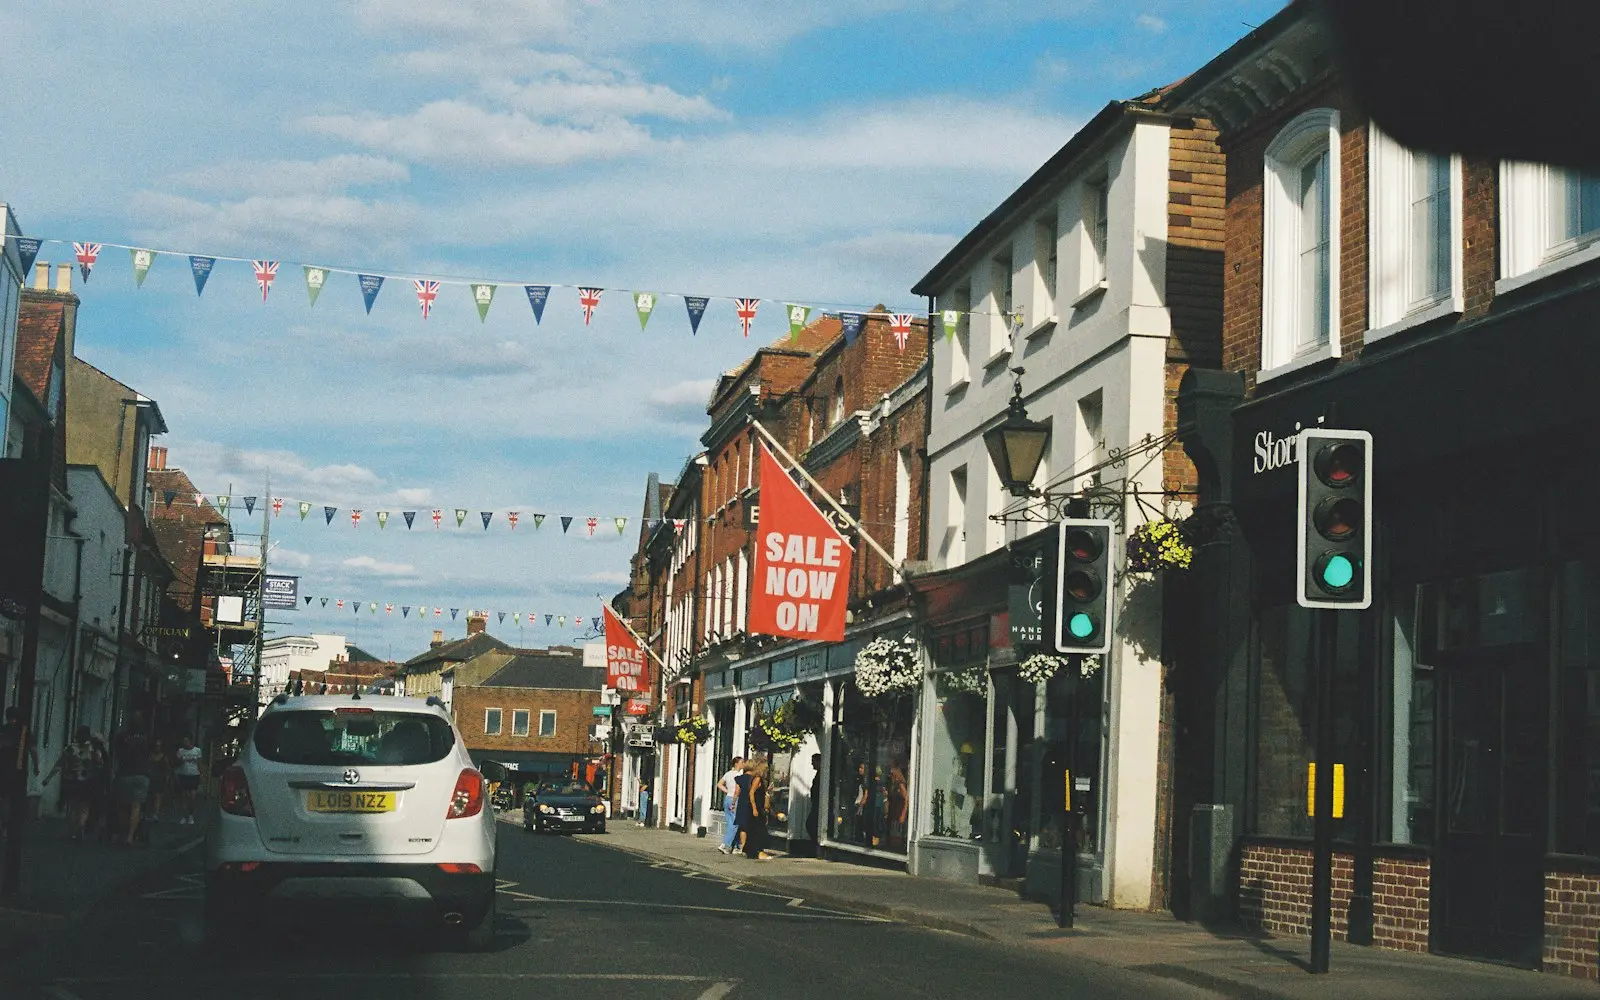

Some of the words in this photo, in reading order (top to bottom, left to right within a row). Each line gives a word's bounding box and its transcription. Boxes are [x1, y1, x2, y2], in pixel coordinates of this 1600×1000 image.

[765, 532, 841, 567] SALE
[1014, 557, 1042, 569] SOF
[270, 581, 290, 589] STACK
[765, 567, 836, 600] NOW
[776, 602, 819, 633] ON
[607, 645, 643, 663] SALE
[609, 661, 642, 677] NOW
[616, 676, 637, 690] ON
[316, 793, 352, 808] LO19
[355, 794, 387, 809] NZZ
